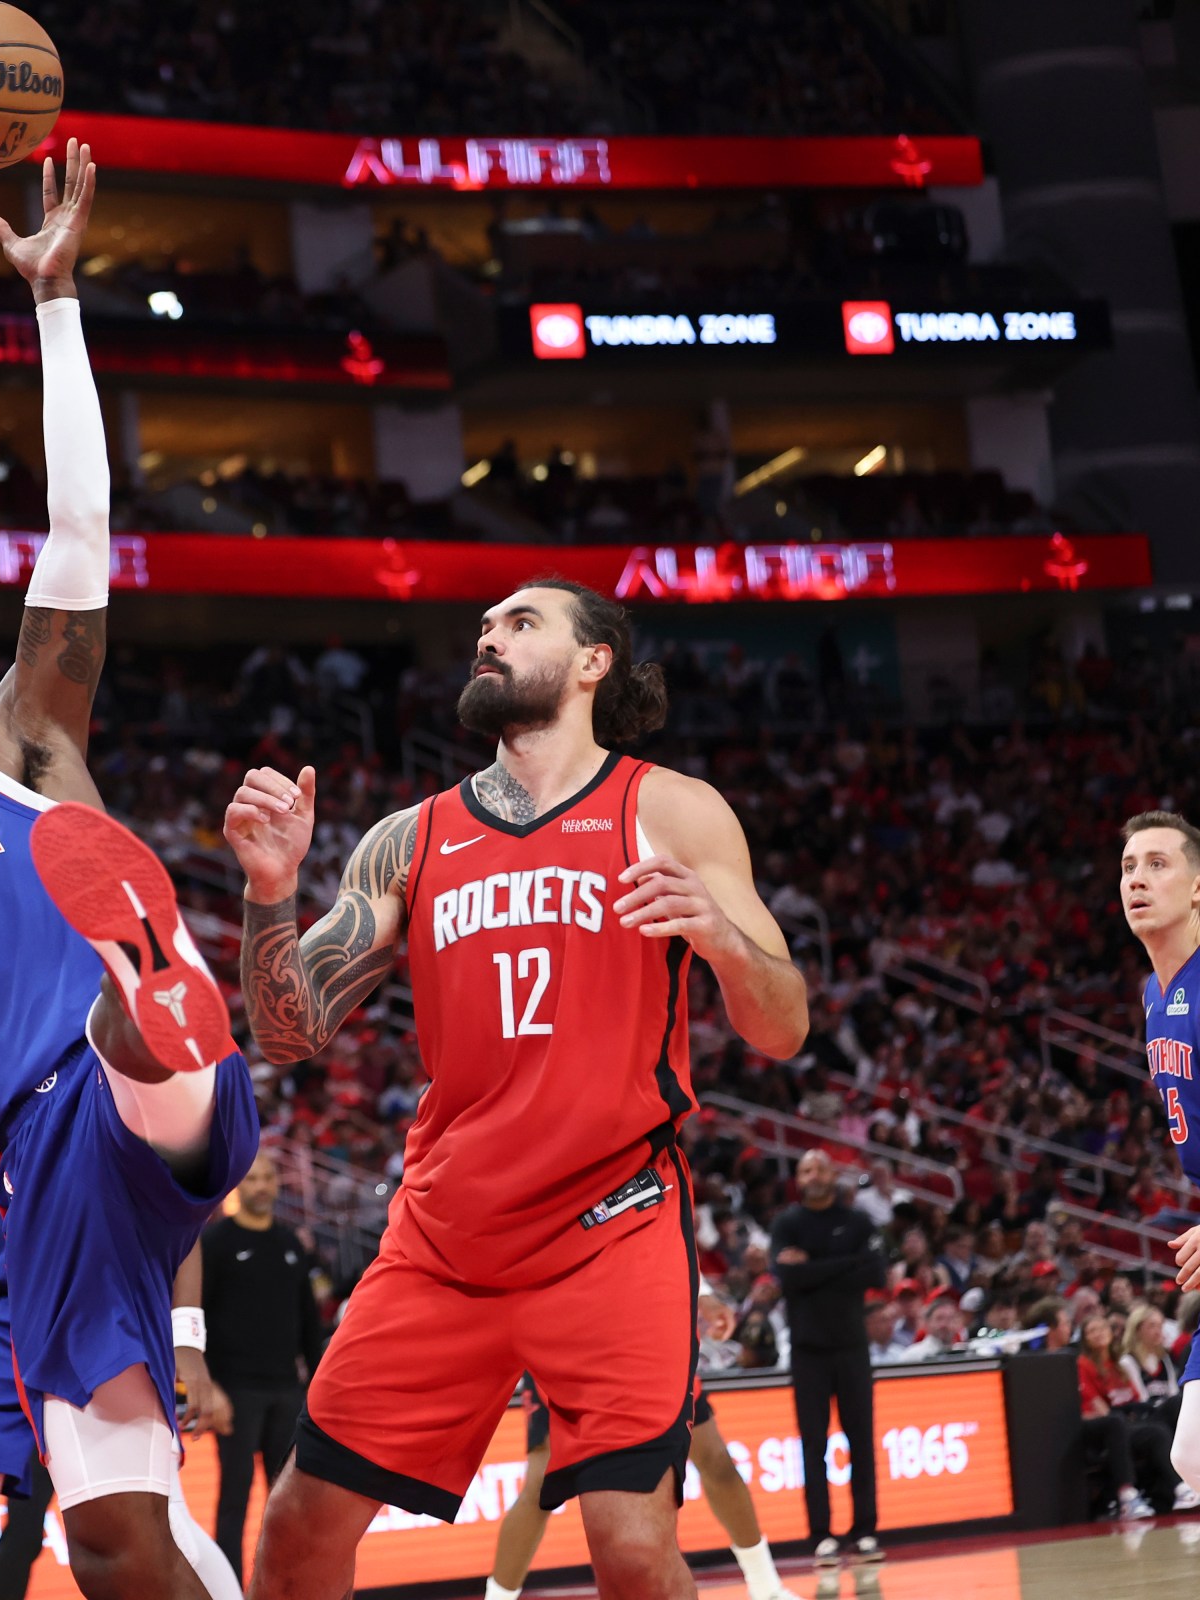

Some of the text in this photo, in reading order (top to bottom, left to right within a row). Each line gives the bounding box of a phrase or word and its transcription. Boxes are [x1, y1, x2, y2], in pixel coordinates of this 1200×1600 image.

[585, 314, 777, 346] TUNDRA ZONE
[895, 312, 1077, 342] TUNDRA ZONE
[561, 824, 613, 834] HERMANN
[562, 817, 613, 828] MEMORIAL
[433, 865, 607, 954] ROCKETS
[492, 947, 553, 1039] 12
[882, 1423, 969, 1480] 1865
